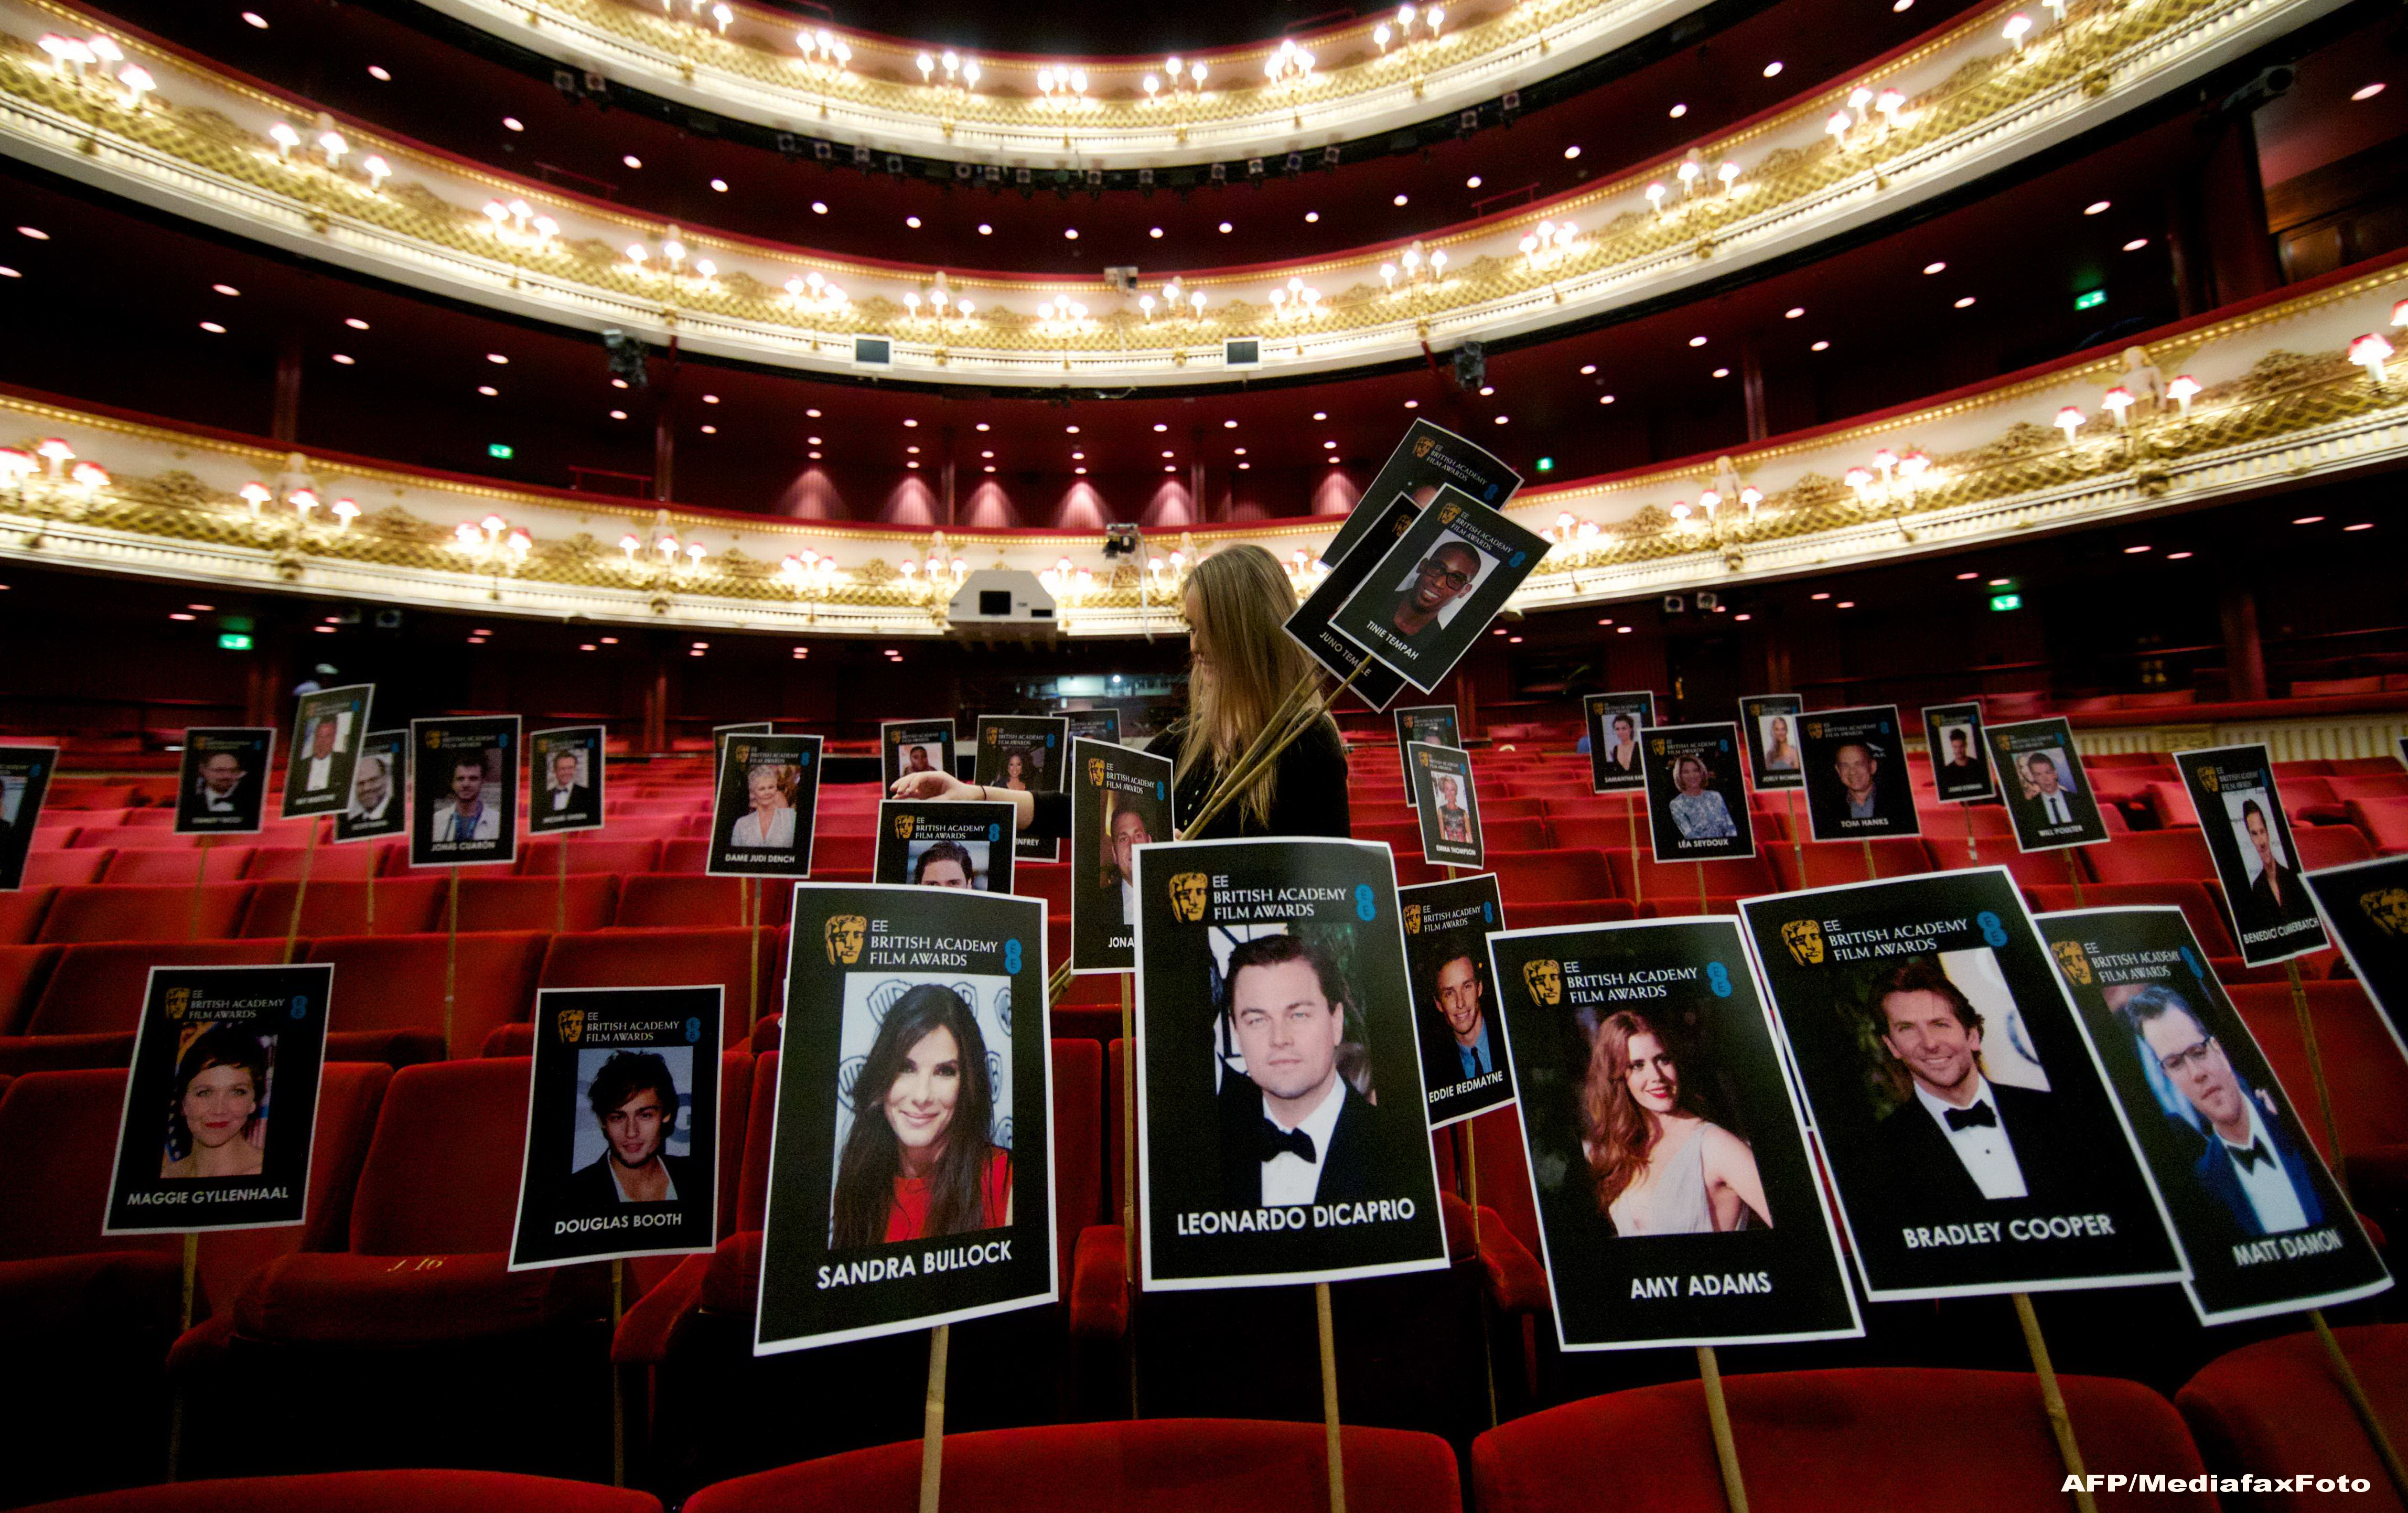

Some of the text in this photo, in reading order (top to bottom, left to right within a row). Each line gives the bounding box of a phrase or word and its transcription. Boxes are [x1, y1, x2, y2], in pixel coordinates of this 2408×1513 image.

[1426, 456, 1468, 481] FILM AWARDS
[1431, 450, 1487, 486] BRITISH ACADEMY
[1460, 511, 1469, 520] EE
[1450, 523, 1493, 551] FILM AWARDS
[1456, 518, 1513, 553] BRITISH ACADEMY
[1319, 631, 1342, 652] JUNO
[1367, 620, 1419, 660] TINIE TEMPAH
[1106, 772, 1155, 788] BRITISH ACADEMY
[1106, 781, 1144, 795] FILM AWARDS
[1693, 839, 1729, 847] SEYDOUX
[1212, 875, 1229, 888] EE
[1213, 888, 1347, 904] BRITISH ACADEMY
[1214, 904, 1315, 920] FILM AWARDS
[1424, 906, 1481, 922] BRITISH ACADEMY
[872, 920, 889, 932] EE
[1424, 918, 1468, 932] FILM AWARDS
[1823, 920, 1842, 932] EE
[1828, 918, 1968, 947] BRITISH ACADEMY
[1108, 937, 1134, 948] JONA
[2243, 928, 2277, 943] BENEDICT
[870, 936, 998, 953] BRITISH ACADEMY
[1833, 938, 1938, 961] FILM AWARDS
[2083, 942, 2100, 954] EE
[869, 952, 968, 967] FILM AWARDS
[1564, 961, 1581, 973] EE
[2091, 950, 2180, 969] BRITISH ACADEMY
[1567, 968, 1697, 989] BRITISH ACADEMY
[2098, 965, 2172, 983] FILM AWARDS
[192, 990, 204, 999] EE
[1570, 985, 1667, 1003] FILM AWARDS
[191, 999, 285, 1008] BRITISH ACADEMY
[214, 1010, 256, 1018] AWARDS
[587, 1012, 599, 1021] EE
[587, 1021, 680, 1032] BRITISH ACADEMY
[586, 1032, 654, 1042] FILM AWARDS
[1429, 1070, 1503, 1103] EDDIE REDMAYNE
[127, 1187, 288, 1205] MAGGIE GYLLENHAAL
[554, 1213, 682, 1235] DOUGLAS BOOTH
[1177, 1198, 1415, 1235] LEONARDO DICAPRIO
[1902, 1214, 2115, 1249] BRADLEY COOPER
[2232, 1229, 2342, 1267] MATT DAMON
[816, 1240, 1012, 1290] SANDRA BULLOCK
[1631, 1272, 1772, 1299] AMY ADAMS
